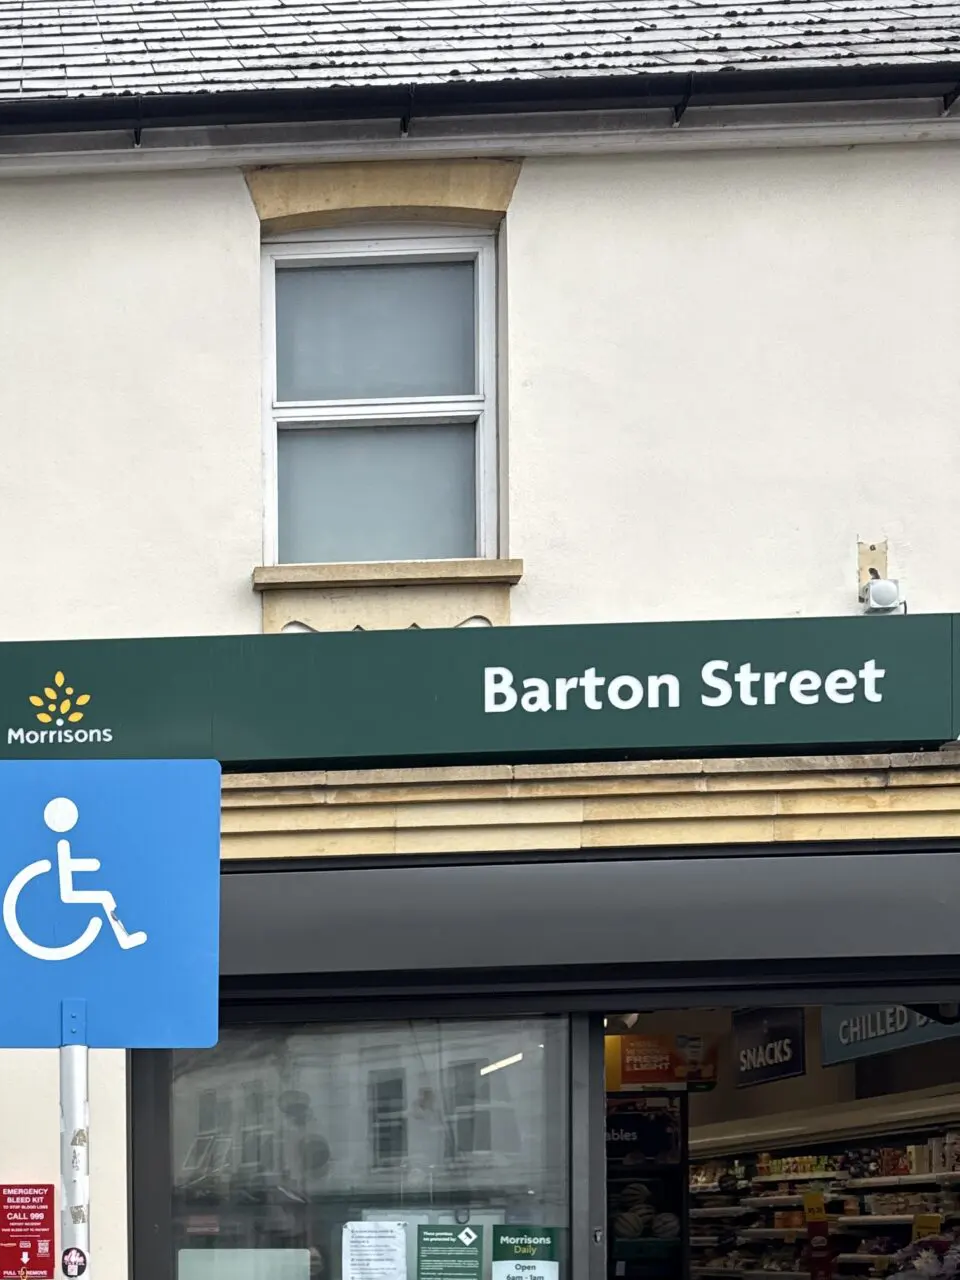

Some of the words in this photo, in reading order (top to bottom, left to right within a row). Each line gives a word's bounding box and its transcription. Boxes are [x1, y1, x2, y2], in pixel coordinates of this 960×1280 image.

[483, 666, 680, 713] Barton
[700, 659, 887, 708] Street
[7, 725, 113, 745] Morrisons
[839, 1006, 909, 1046] CHILLED
[738, 1038, 793, 1072] SNACKS
[6, 1212, 29, 1220] CALL
[30, 1212, 45, 1220] 999
[500, 1235, 552, 1244] Morrisons
[514, 1245, 537, 1256] Daily
[514, 1263, 537, 1272] Open
